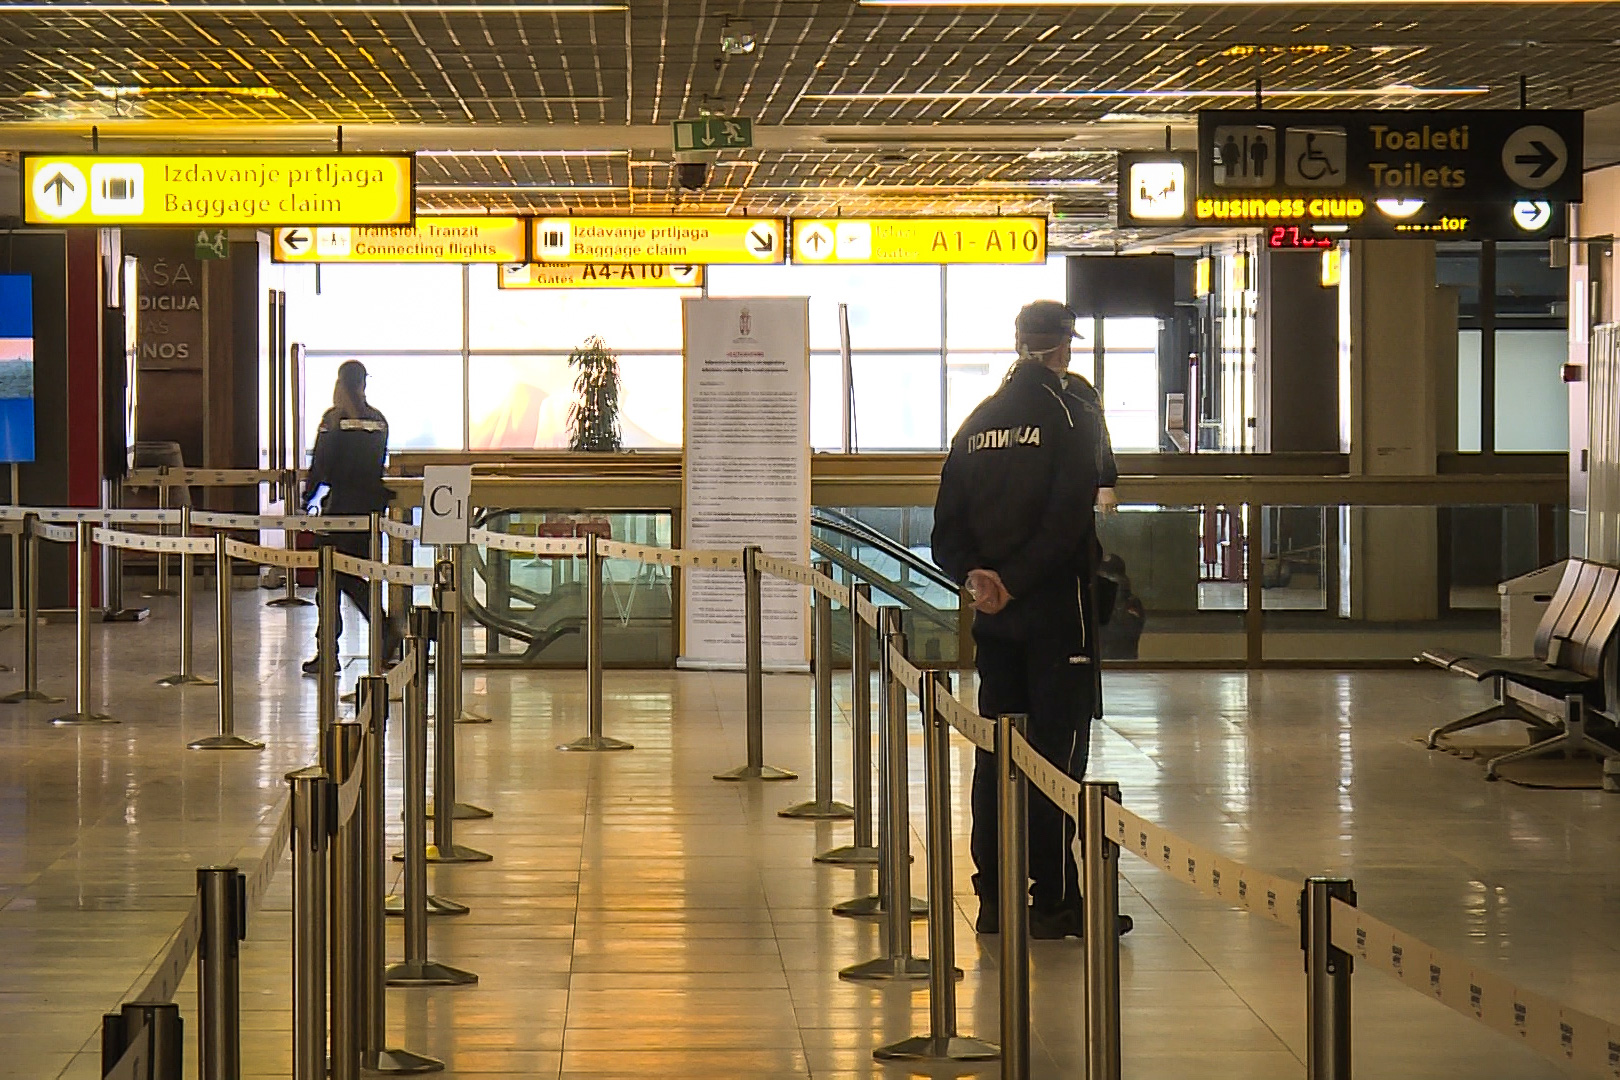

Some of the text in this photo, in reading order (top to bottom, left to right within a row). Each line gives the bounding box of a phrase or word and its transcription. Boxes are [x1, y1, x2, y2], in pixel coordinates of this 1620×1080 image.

[1370, 125, 1469, 151] Toaleti
[164, 163, 384, 189] Izdavanje prtljaga
[1369, 161, 1466, 189] Toilets
[164, 193, 342, 218] Baggage claim
[429, 225, 479, 238] Tranzit
[574, 225, 709, 241] Izdavanje prtljaga
[355, 243, 497, 258] Connecting flights
[574, 243, 688, 258] Baggage claim
